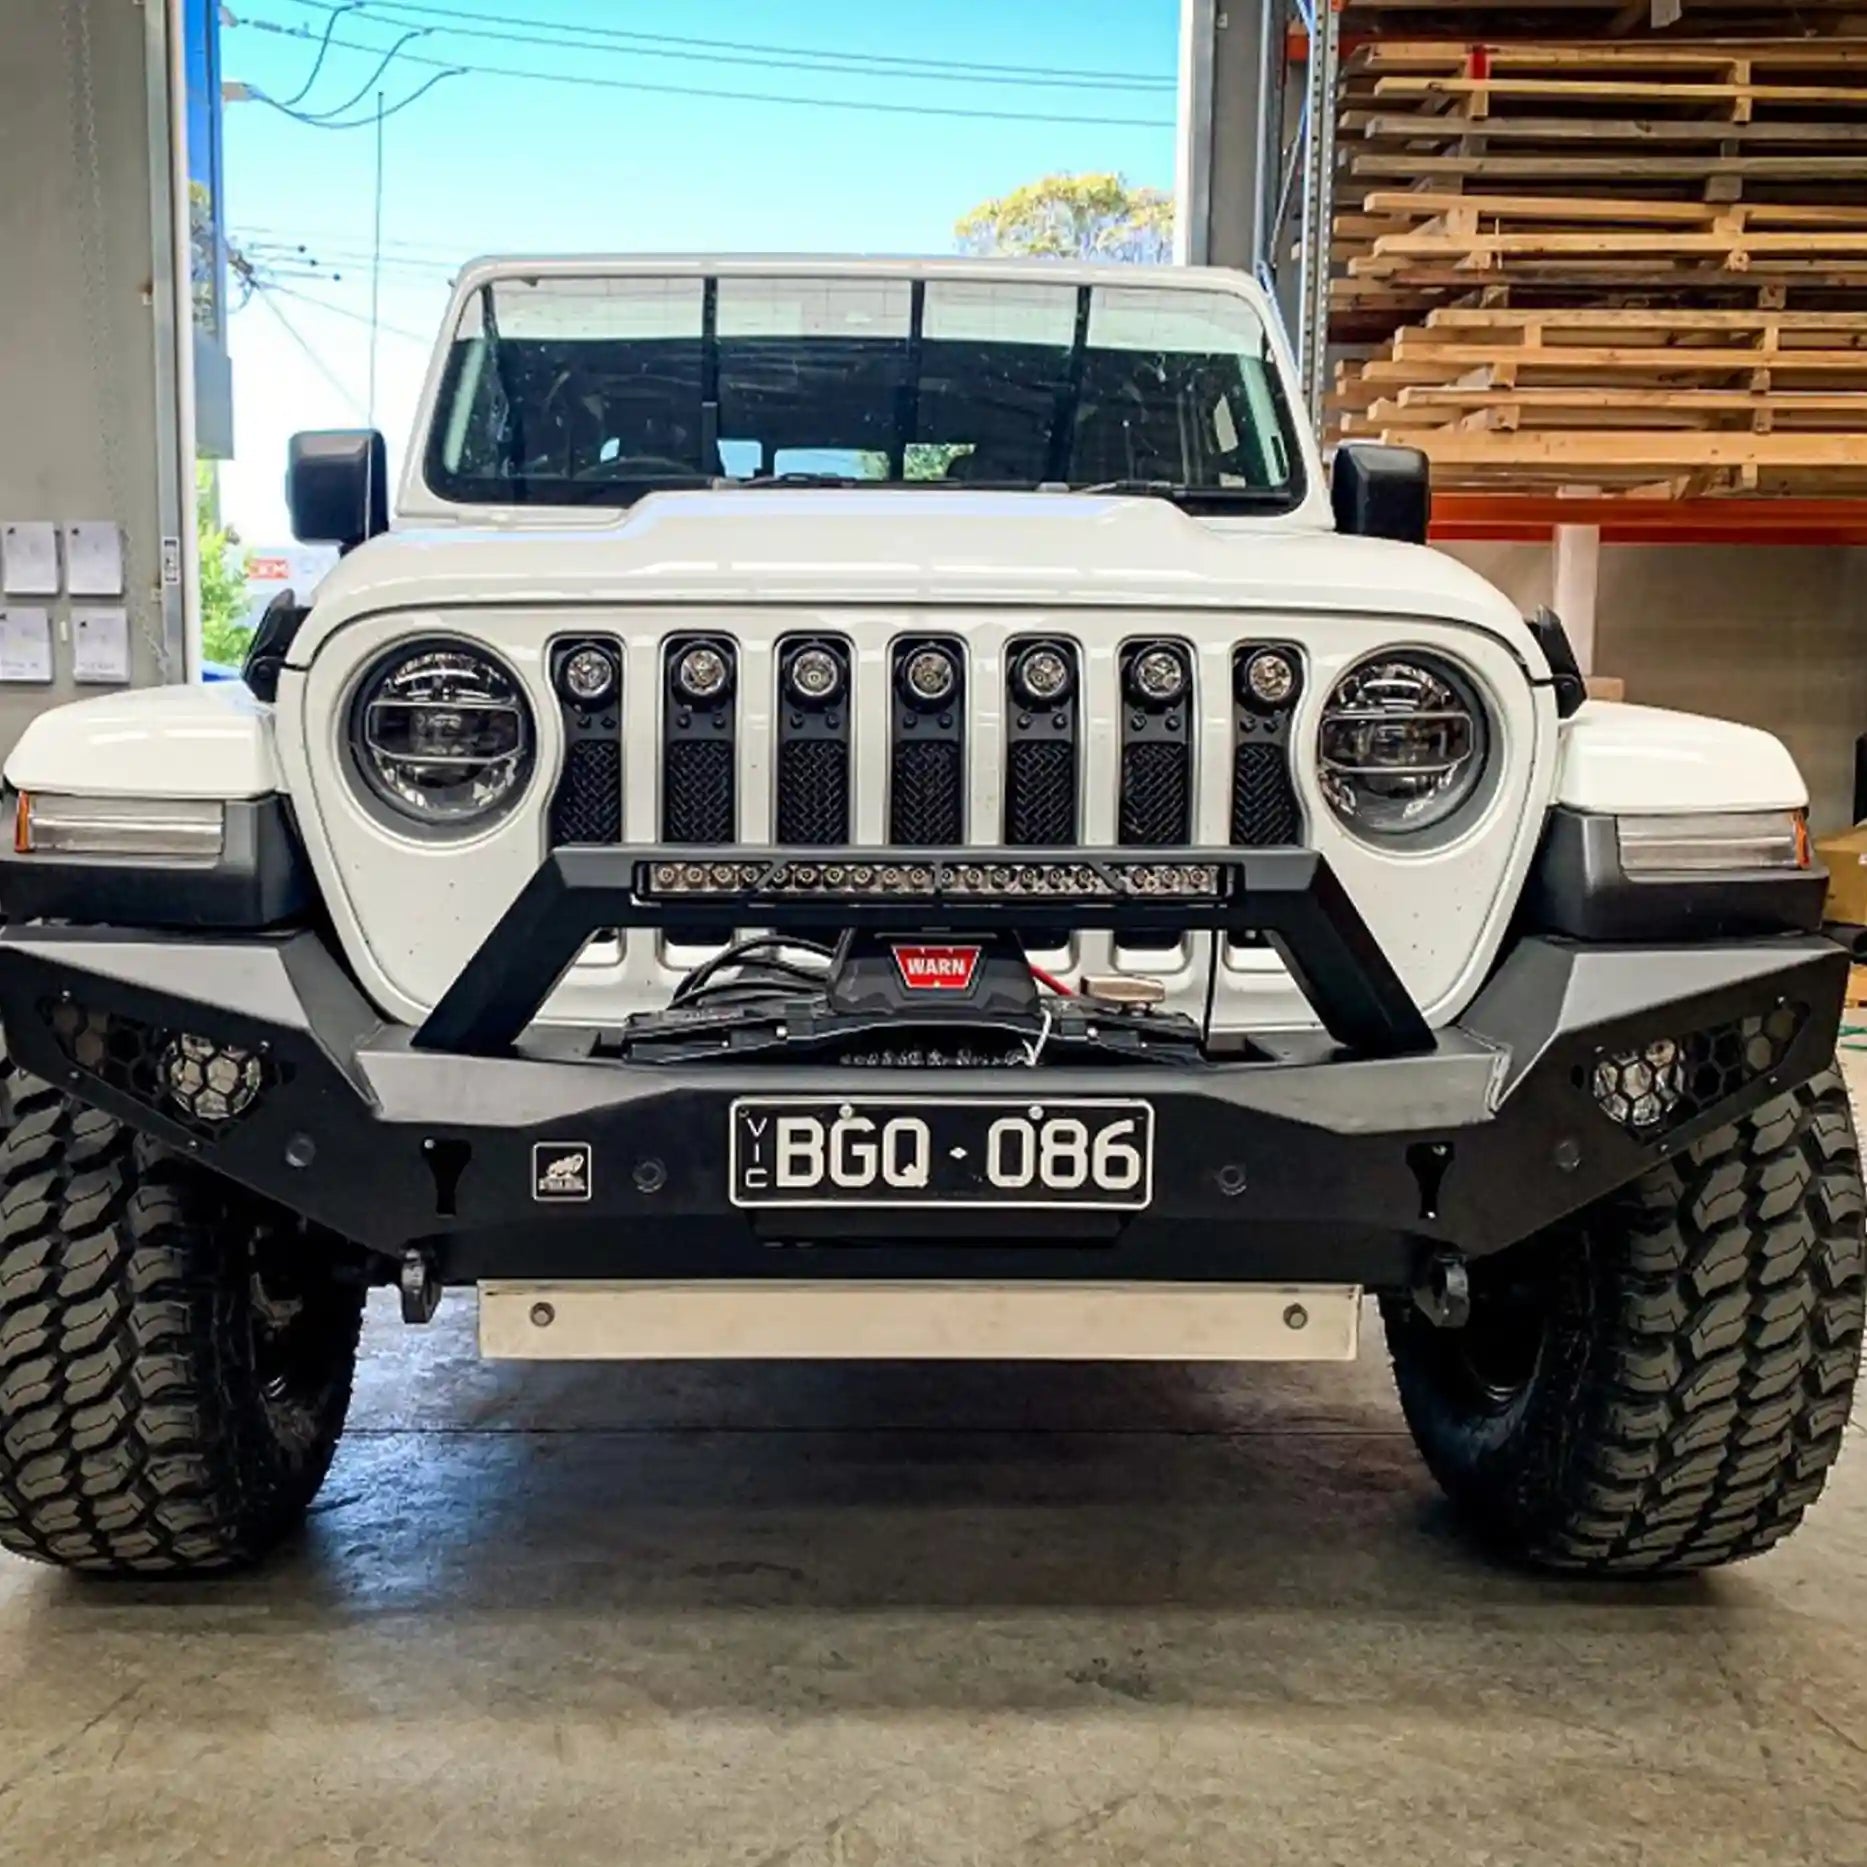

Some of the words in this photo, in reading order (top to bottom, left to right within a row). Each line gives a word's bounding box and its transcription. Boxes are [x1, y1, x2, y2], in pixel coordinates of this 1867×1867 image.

[907, 958, 965, 976] WARN
[745, 1117, 768, 1188] VIC
[776, 1116, 930, 1188] BGQ
[987, 1117, 1142, 1190] 086
